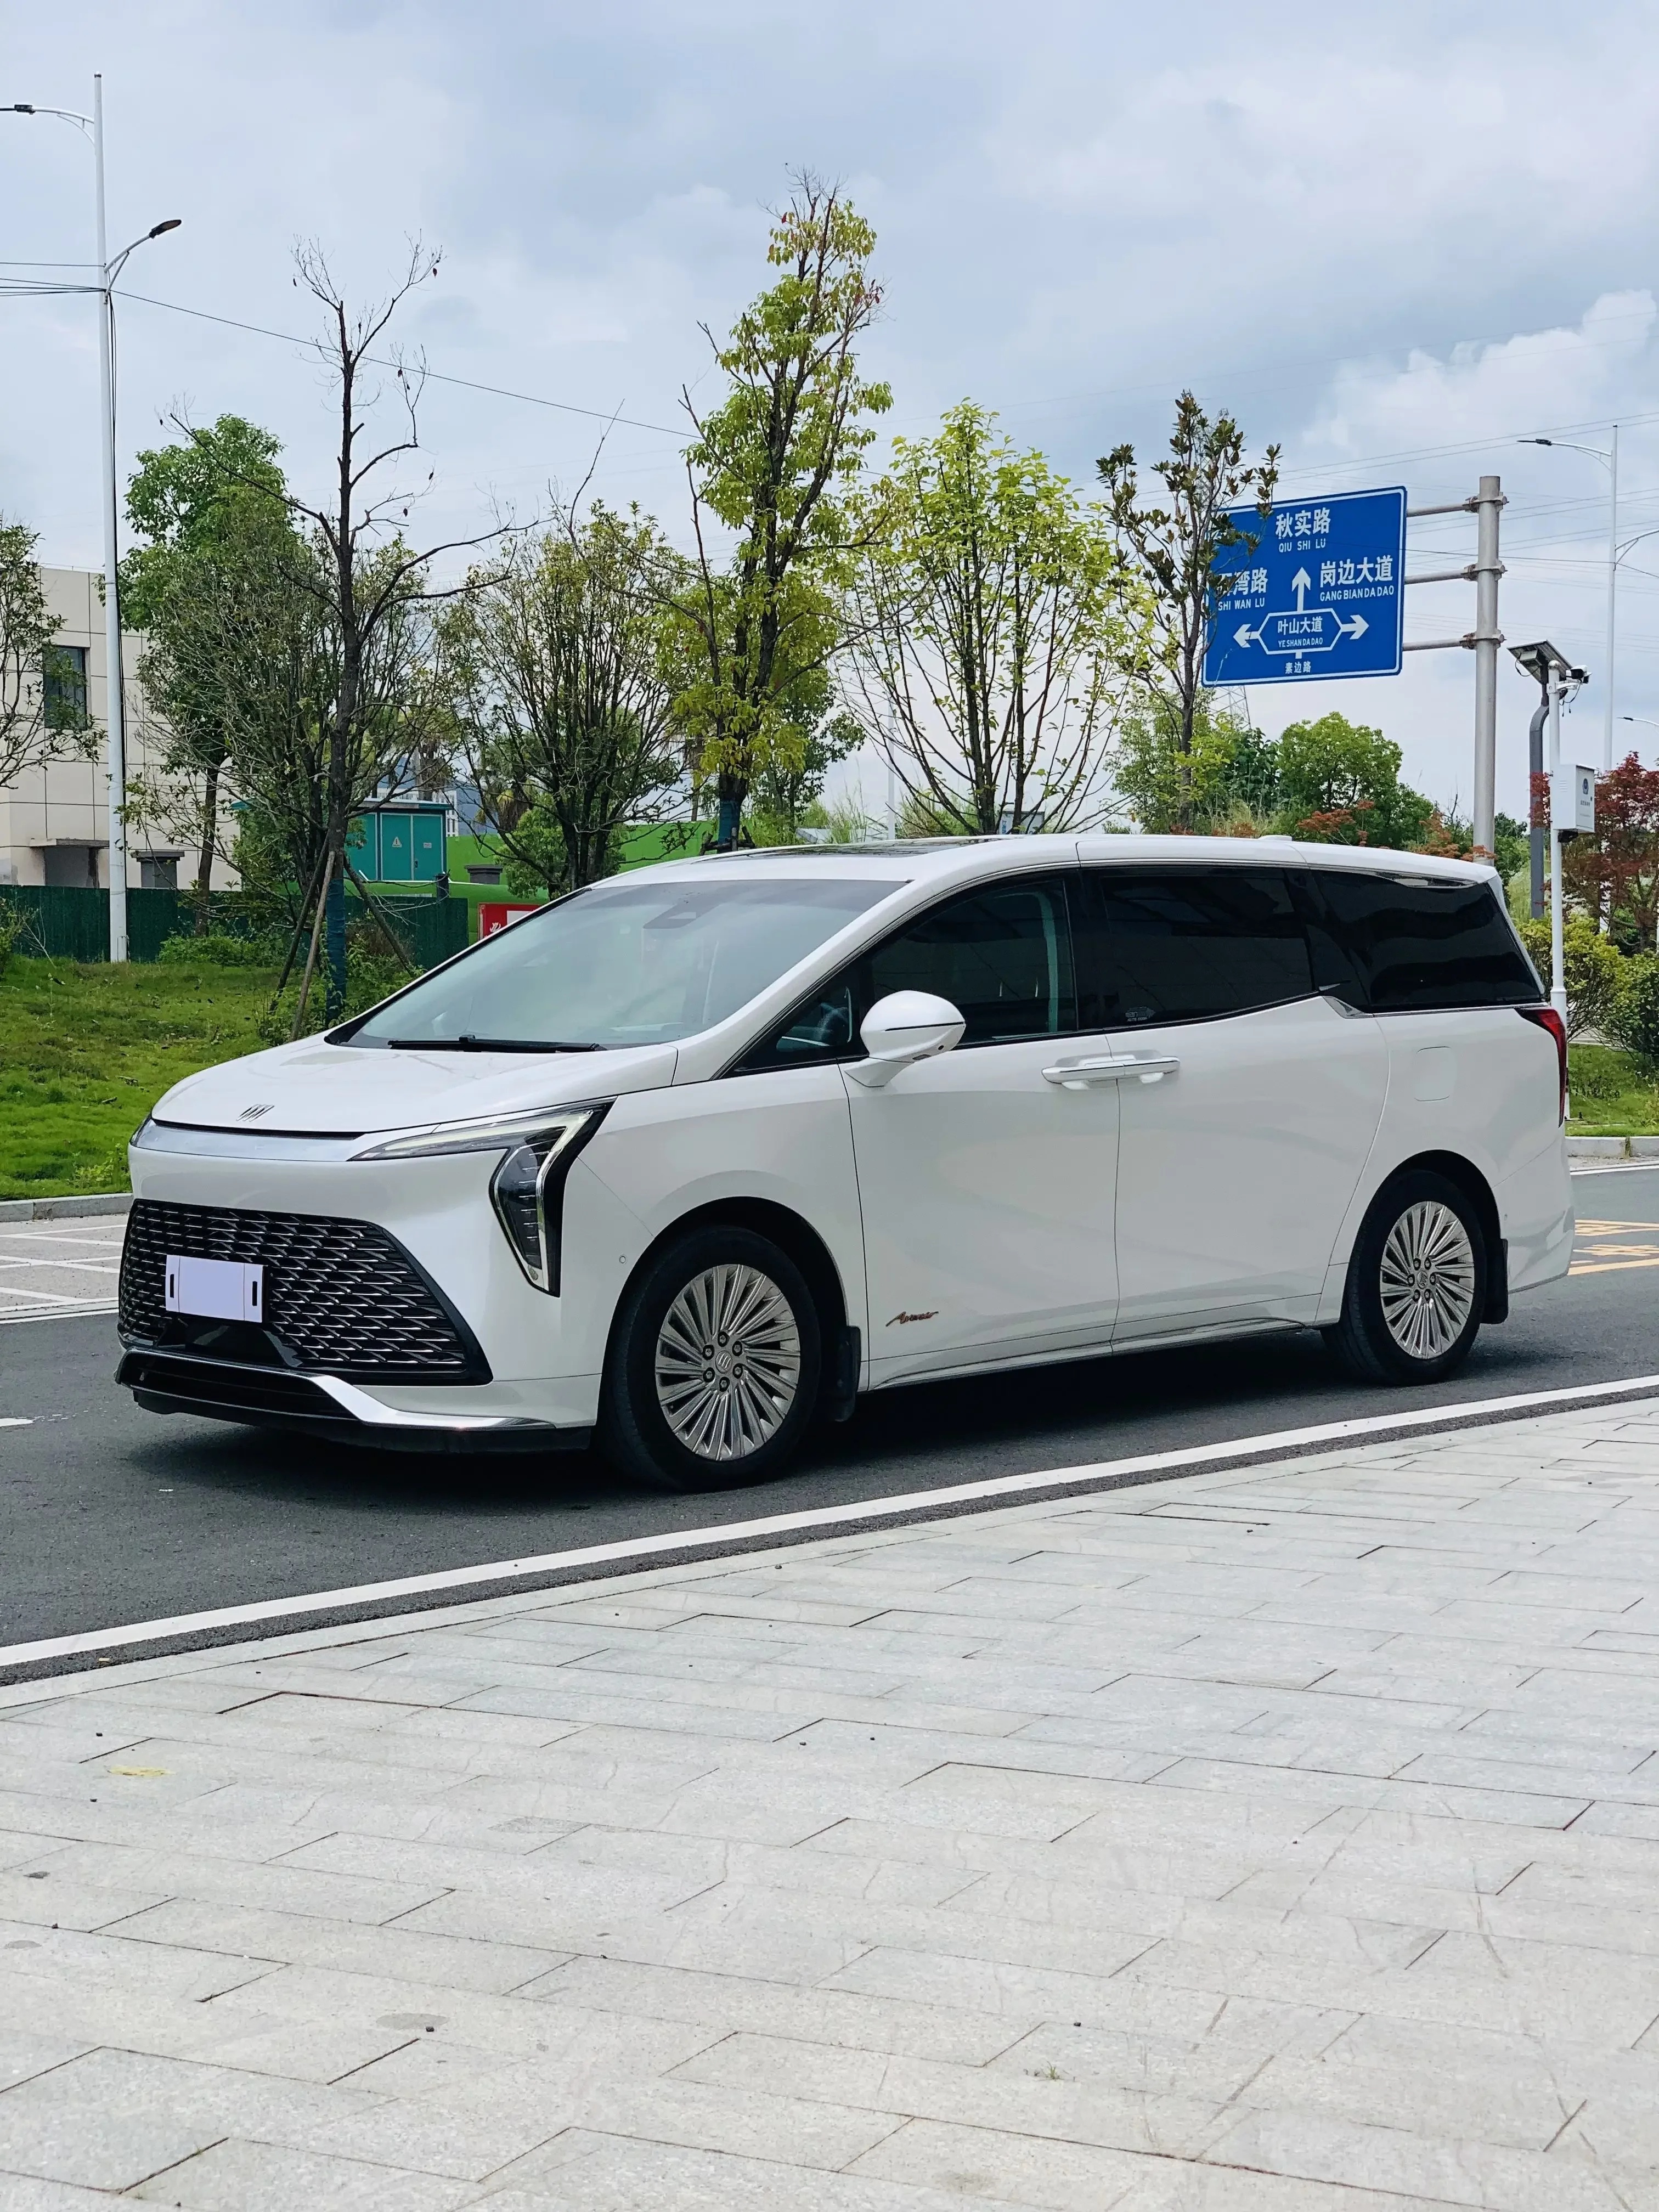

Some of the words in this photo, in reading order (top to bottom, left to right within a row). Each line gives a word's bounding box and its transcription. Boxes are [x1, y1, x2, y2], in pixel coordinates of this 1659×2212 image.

[1276, 507, 1331, 539] 秋实路
[1279, 542, 1292, 553] QIU
[1297, 540, 1311, 551] SHI
[1316, 538, 1326, 549] LU
[1320, 555, 1393, 588] 岗边大道
[1218, 601, 1231, 611] SHI
[1234, 599, 1251, 610] WAN
[1255, 597, 1265, 608] LU
[1278, 616, 1323, 635] 叶山大道
